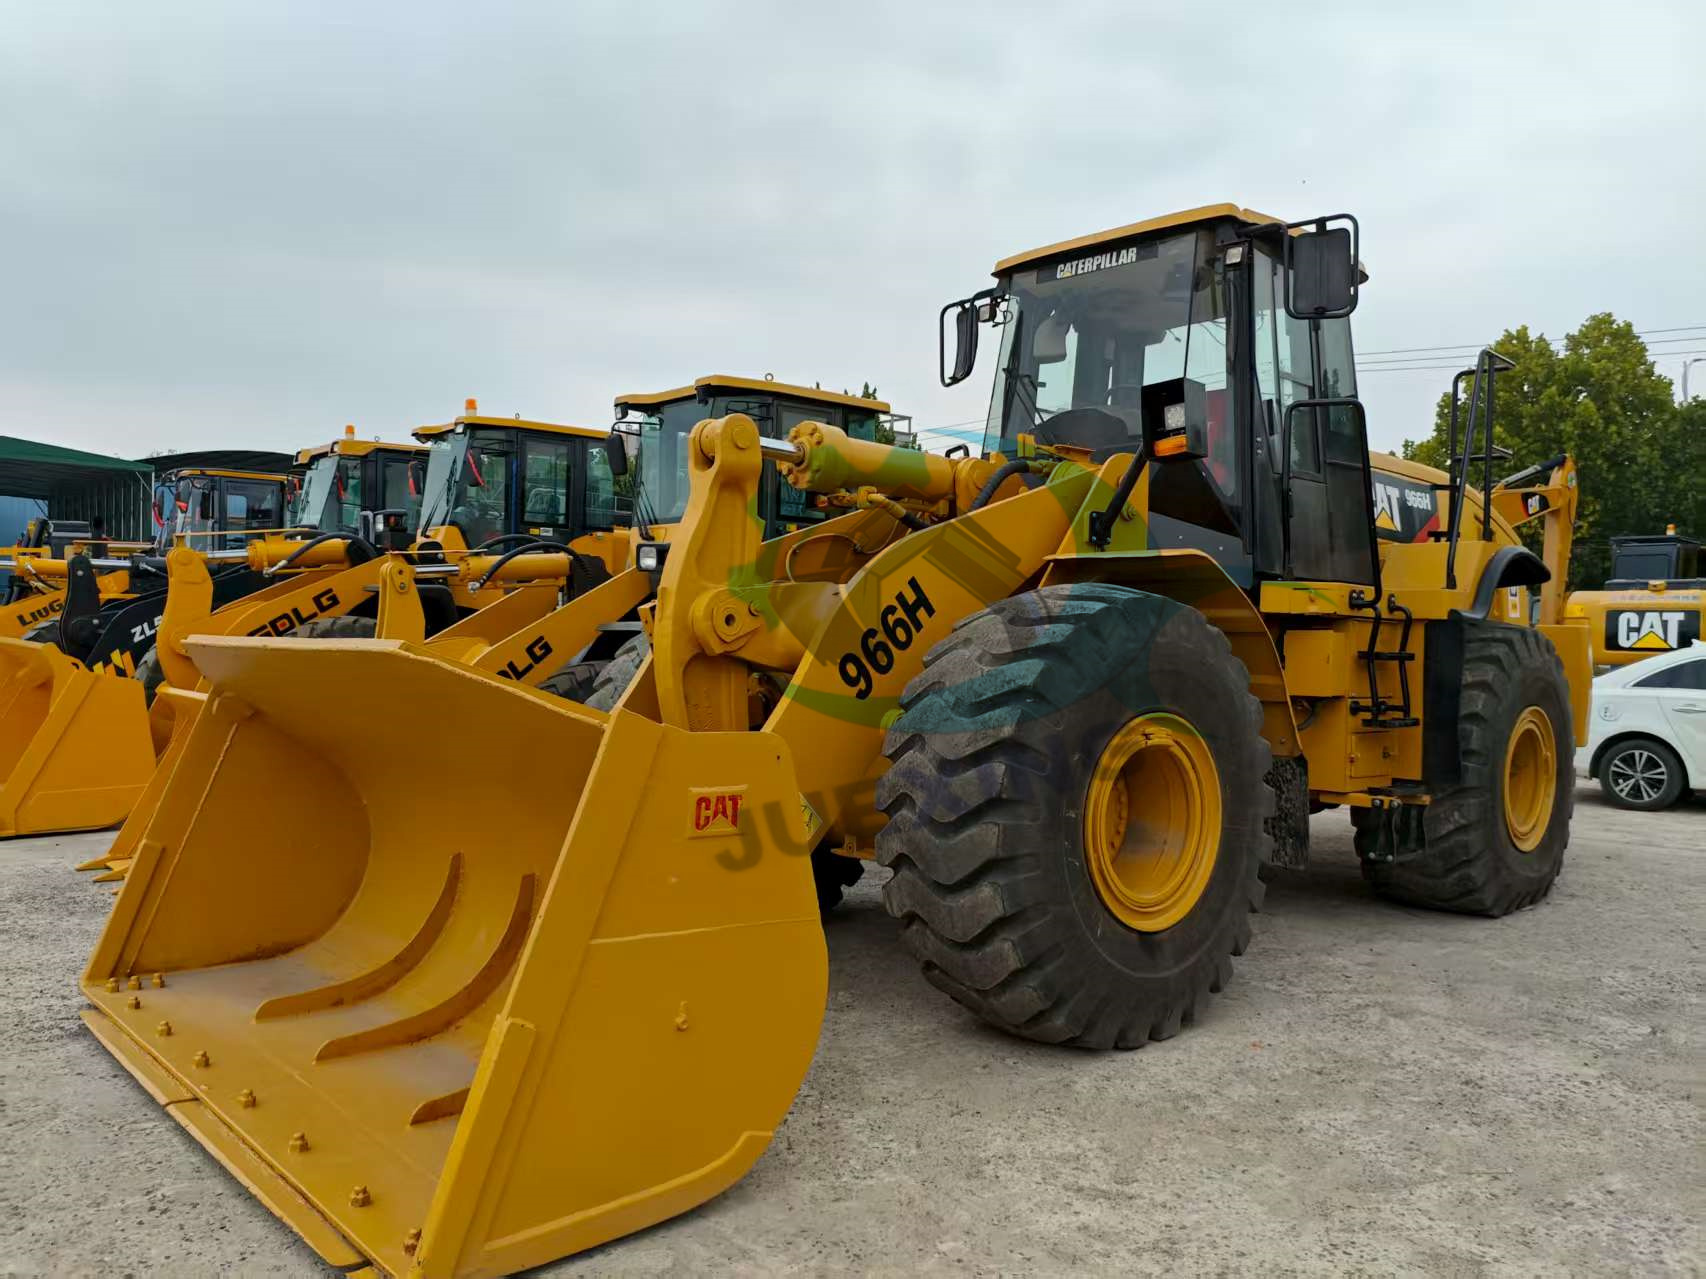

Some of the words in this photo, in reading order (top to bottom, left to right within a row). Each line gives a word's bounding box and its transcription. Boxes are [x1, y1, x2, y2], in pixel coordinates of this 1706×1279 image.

[1056, 247, 1137, 279] CATERPILLAR
[1372, 482, 1402, 532] AT
[1404, 488, 1432, 511] 966H
[838, 575, 936, 700] 966H
[1617, 611, 1686, 649] CAT
[695, 795, 743, 832] CAT
